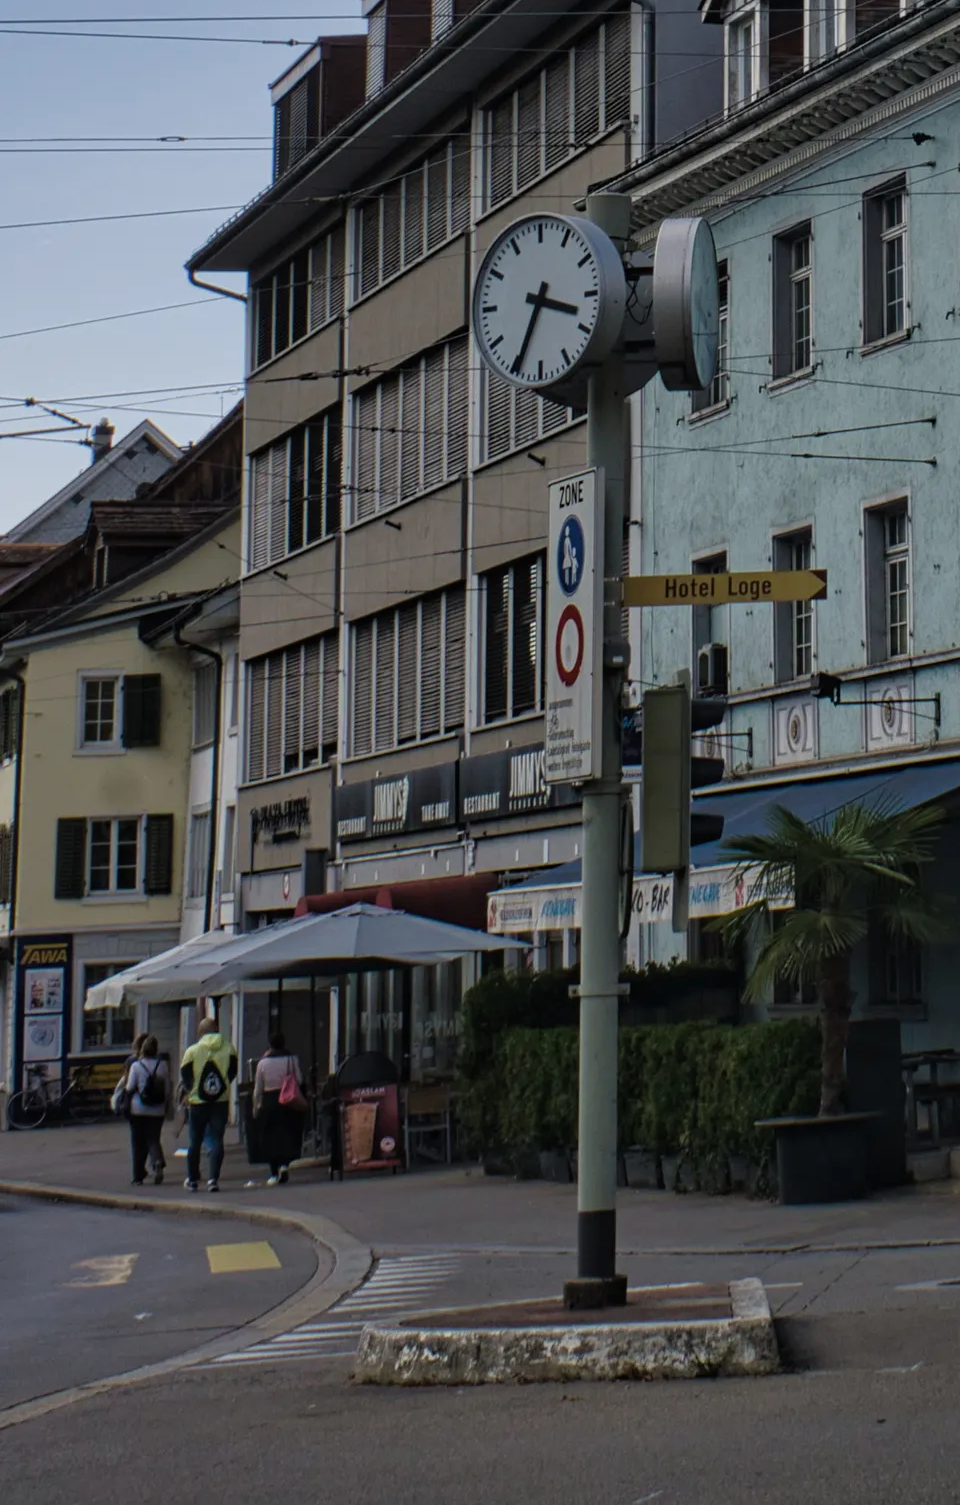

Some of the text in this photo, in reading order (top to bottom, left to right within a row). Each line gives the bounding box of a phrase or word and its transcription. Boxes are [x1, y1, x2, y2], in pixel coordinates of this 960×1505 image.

[559, 480, 584, 509] ZONE
[664, 576, 772, 600] Hotel Loge
[373, 779, 404, 823] JIMMYS
[464, 791, 500, 815] RESTAURANT
[337, 816, 367, 836] RESTAURANT
[20, 943, 68, 966] TAWA
